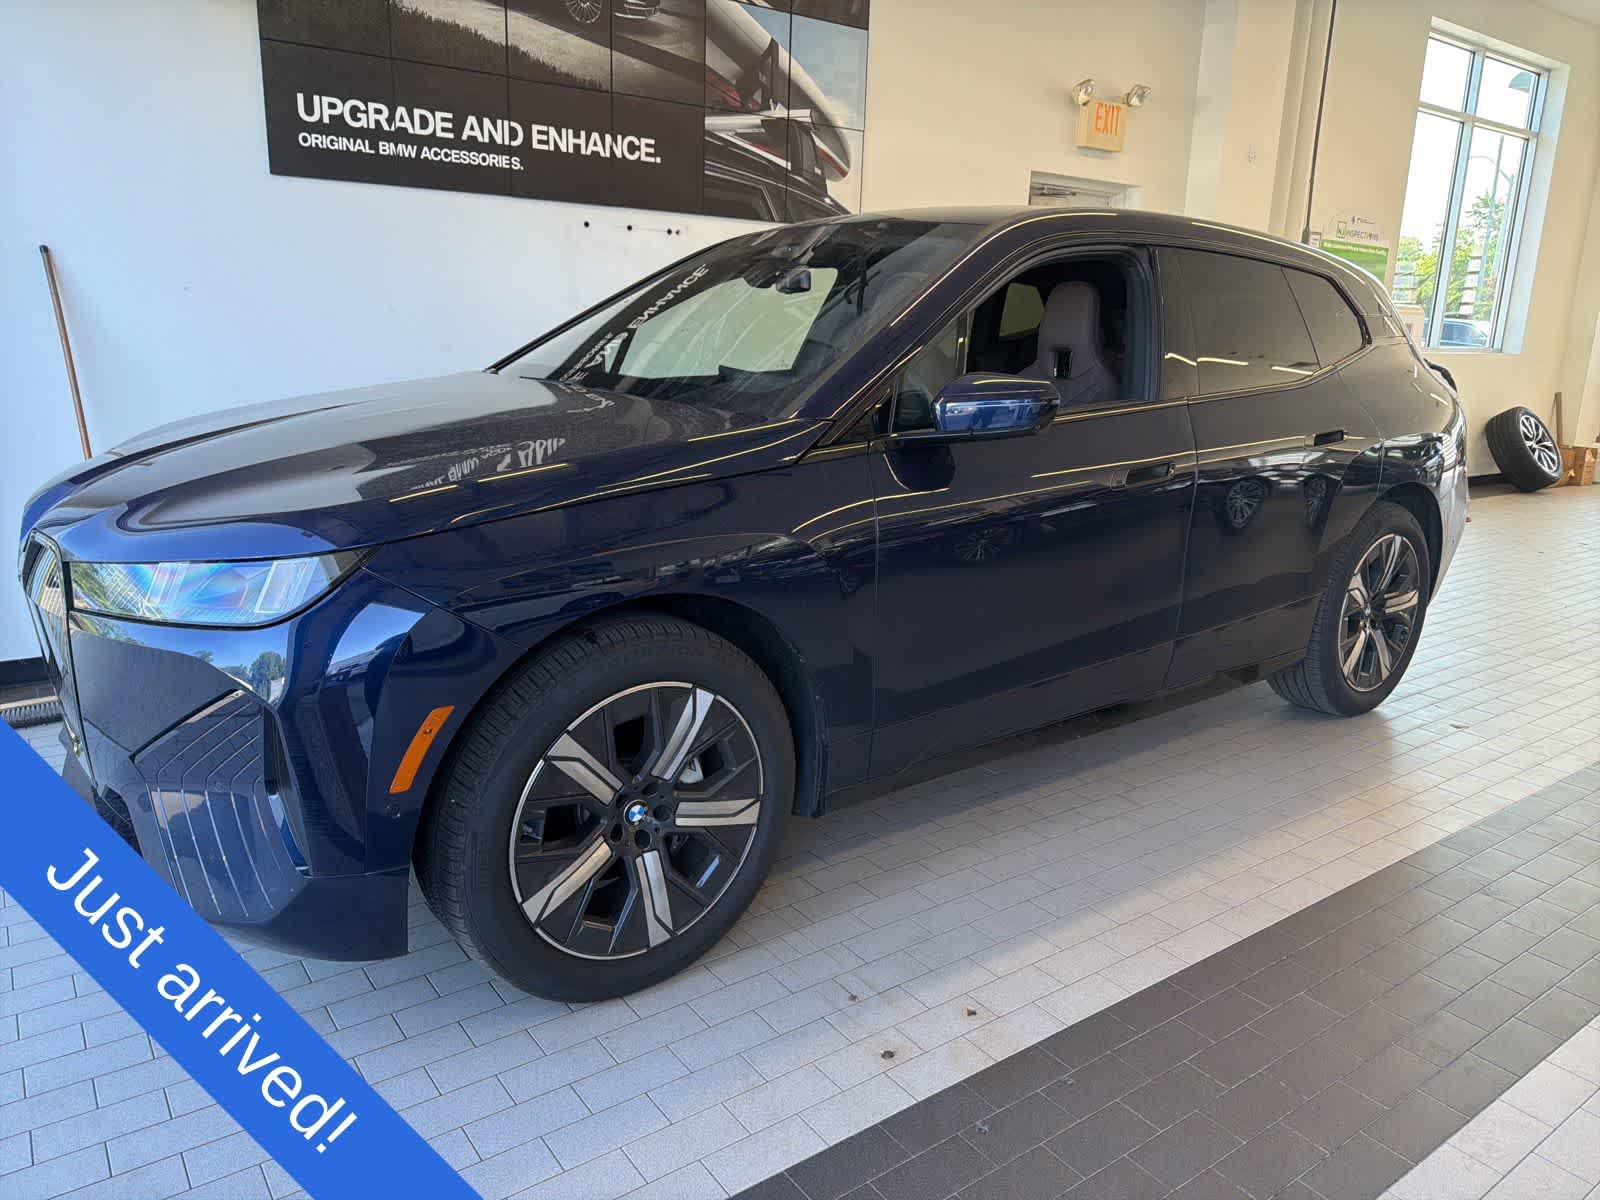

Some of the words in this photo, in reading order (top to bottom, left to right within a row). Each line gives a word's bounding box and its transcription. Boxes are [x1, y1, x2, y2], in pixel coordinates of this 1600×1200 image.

[297, 92, 455, 140] UPGRADE
[461, 115, 524, 147] AND
[531, 124, 662, 164] ENHANCE.
[1095, 102, 1122, 136] EXIT
[298, 132, 375, 154] ORIGINAL
[378, 141, 417, 158] BMW
[420, 146, 525, 171] ACCESSORIES.
